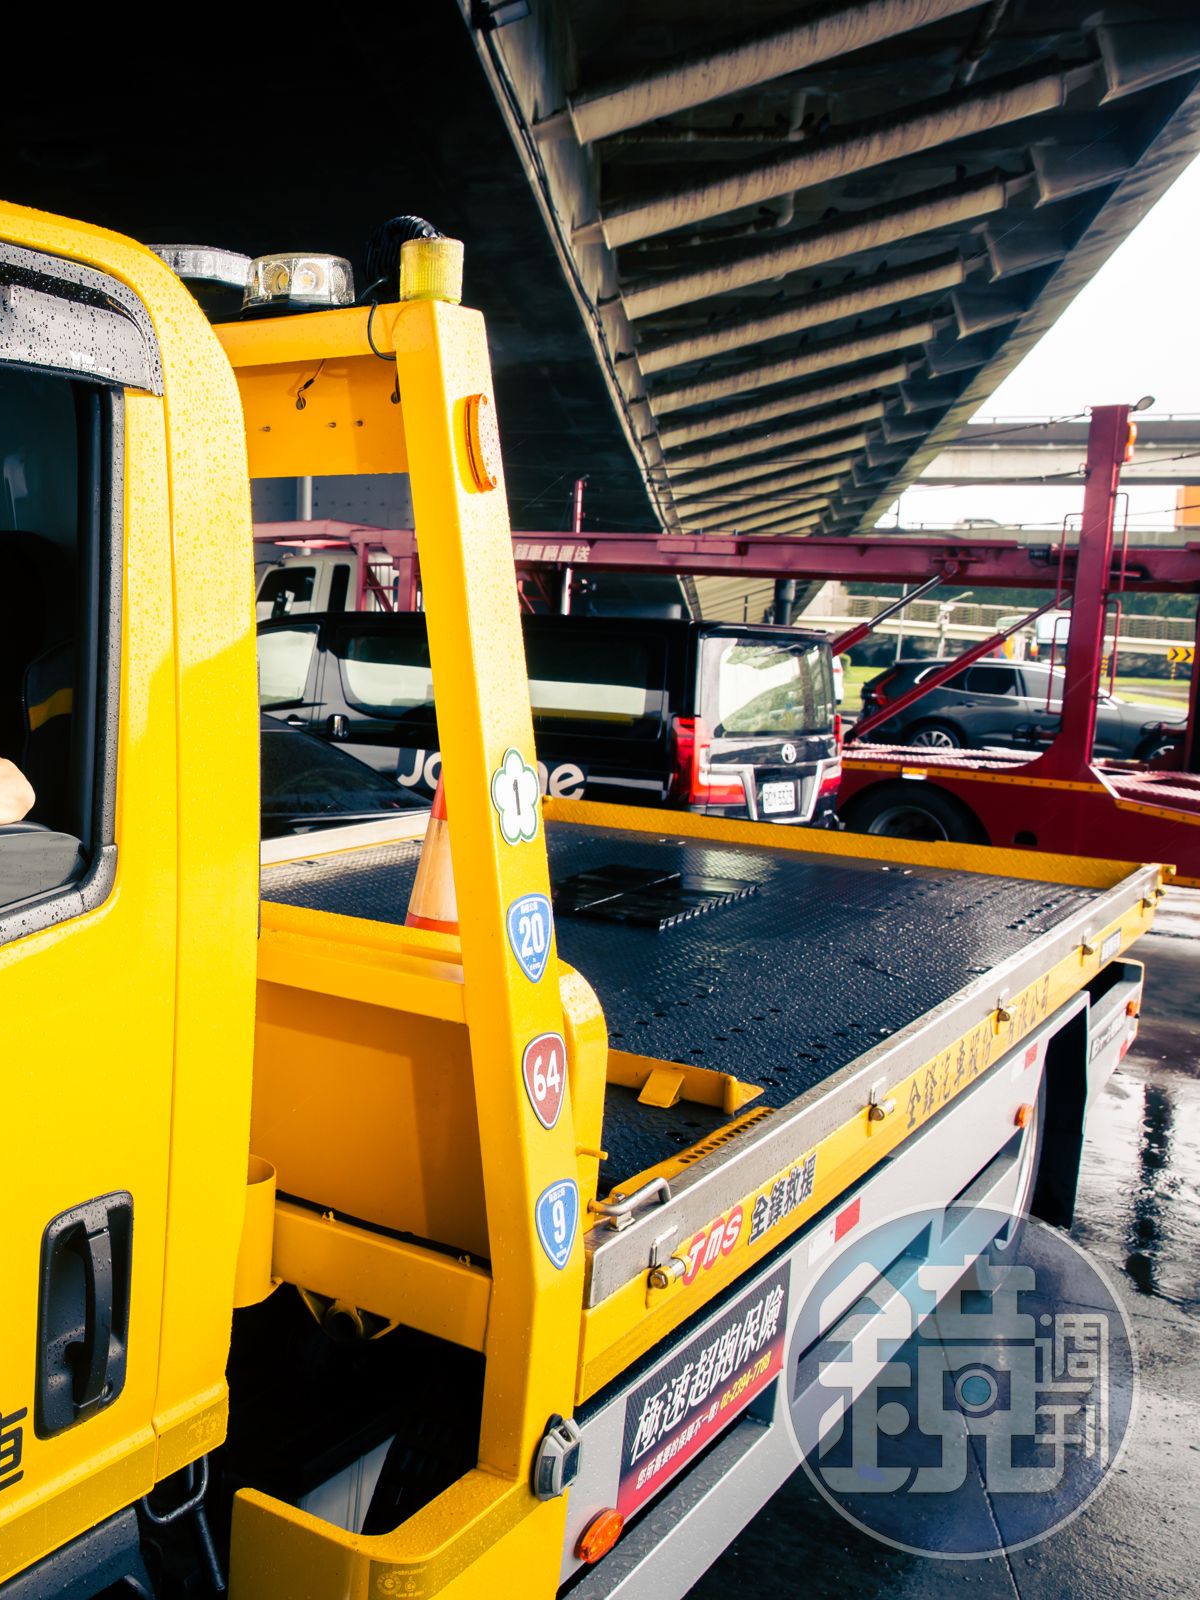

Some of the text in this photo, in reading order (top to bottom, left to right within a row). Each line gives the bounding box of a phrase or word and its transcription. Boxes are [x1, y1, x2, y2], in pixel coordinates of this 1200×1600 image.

[513, 779, 521, 815] 1
[519, 912, 545, 958] 20
[533, 1050, 560, 1101] 64
[552, 1199, 566, 1244] 9
[748, 1152, 817, 1246] 全鋒救援
[630, 1284, 784, 1467] 極速超跑保險
